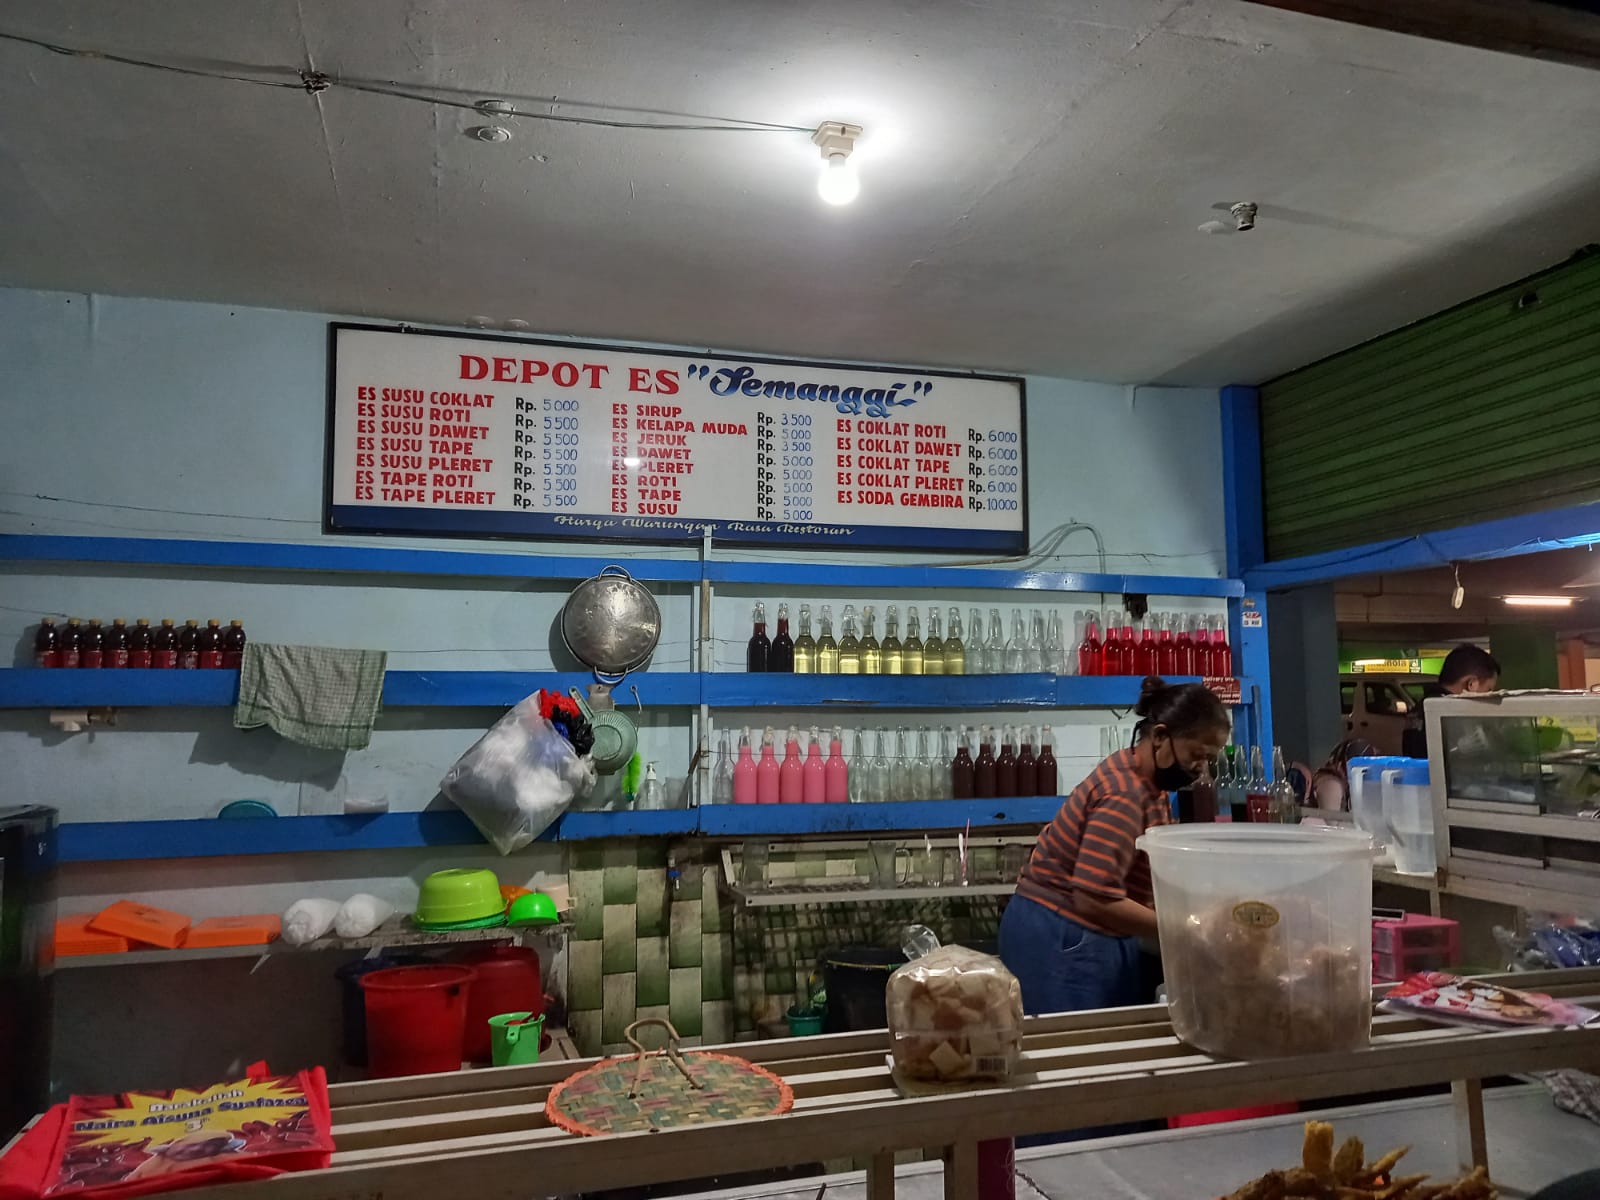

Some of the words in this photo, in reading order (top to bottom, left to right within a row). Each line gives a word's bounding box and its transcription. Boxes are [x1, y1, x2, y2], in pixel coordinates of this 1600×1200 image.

[459, 355, 609, 389] DEPOT
[628, 367, 680, 395] ES
[358, 386, 376, 401] ES
[381, 387, 424, 403] SUSU
[430, 391, 494, 408] COKLAT
[515, 397, 537, 413] Rp.
[358, 403, 376, 417] ES
[381, 405, 423, 420] SUSU
[430, 408, 471, 423] ROTI
[515, 414, 537, 429] Rp.
[612, 403, 628, 415] ES
[636, 405, 682, 418] SIRUP
[757, 412, 776, 426] Rp.
[357, 420, 376, 434] ES
[381, 422, 423, 436] SUSU
[429, 424, 490, 440] DAWET
[515, 430, 536, 445] Rp.
[612, 418, 628, 429] ES
[636, 419, 695, 433] KELAPA
[702, 422, 747, 435] MUDA
[757, 425, 776, 440] Rp.
[836, 419, 852, 433] ES
[857, 421, 910, 437] COKLAT
[915, 423, 946, 438] ROTI
[968, 428, 985, 444] Rp.
[357, 437, 375, 450] ES
[381, 439, 422, 452] SUSU
[430, 441, 473, 455] TAPE
[515, 446, 536, 461] Rp.
[612, 432, 628, 444] ES
[637, 434, 687, 446] JERUK
[757, 439, 776, 453] Rp.
[837, 437, 852, 451] ES
[857, 438, 910, 455] COKLAT
[915, 441, 961, 457] DAWET
[968, 445, 985, 461] Rp.
[357, 454, 375, 467] ES
[380, 455, 422, 470] SUSU
[428, 457, 493, 473] PLERET
[514, 462, 535, 477] Rp.
[612, 446, 628, 457] ES
[637, 448, 691, 460] DAWET
[757, 453, 776, 467] Rp.
[837, 454, 852, 468] ES
[858, 456, 910, 472] COKLAT
[915, 459, 949, 474] TAPE
[969, 462, 985, 478] Rp.
[356, 470, 374, 484] ES
[380, 472, 427, 486] TAPE
[433, 473, 474, 488] ROTI
[514, 478, 535, 493] Rp.
[612, 460, 628, 471] ES
[638, 462, 694, 474] PLERET
[757, 467, 776, 482] Rp.
[612, 474, 628, 485] ES
[637, 475, 677, 487] ROTI
[757, 480, 776, 495] Rp.
[837, 472, 852, 486] ES
[857, 474, 910, 489] COKLAT
[915, 476, 964, 492] PLERET
[969, 480, 985, 495] Rp.
[355, 486, 374, 500] ES
[381, 488, 425, 502] TAPE
[432, 490, 495, 505] PLERET
[513, 494, 534, 509] Rp.
[612, 488, 627, 499] ES
[638, 489, 681, 501] TAPE
[757, 493, 776, 507] Rp.
[837, 490, 853, 504] ES
[857, 490, 894, 505] SODA
[900, 493, 964, 509] GEMBIRA
[969, 497, 985, 512] Rp.
[611, 502, 627, 513] ES
[638, 503, 678, 516] SUSU
[757, 507, 776, 521] Rp.
